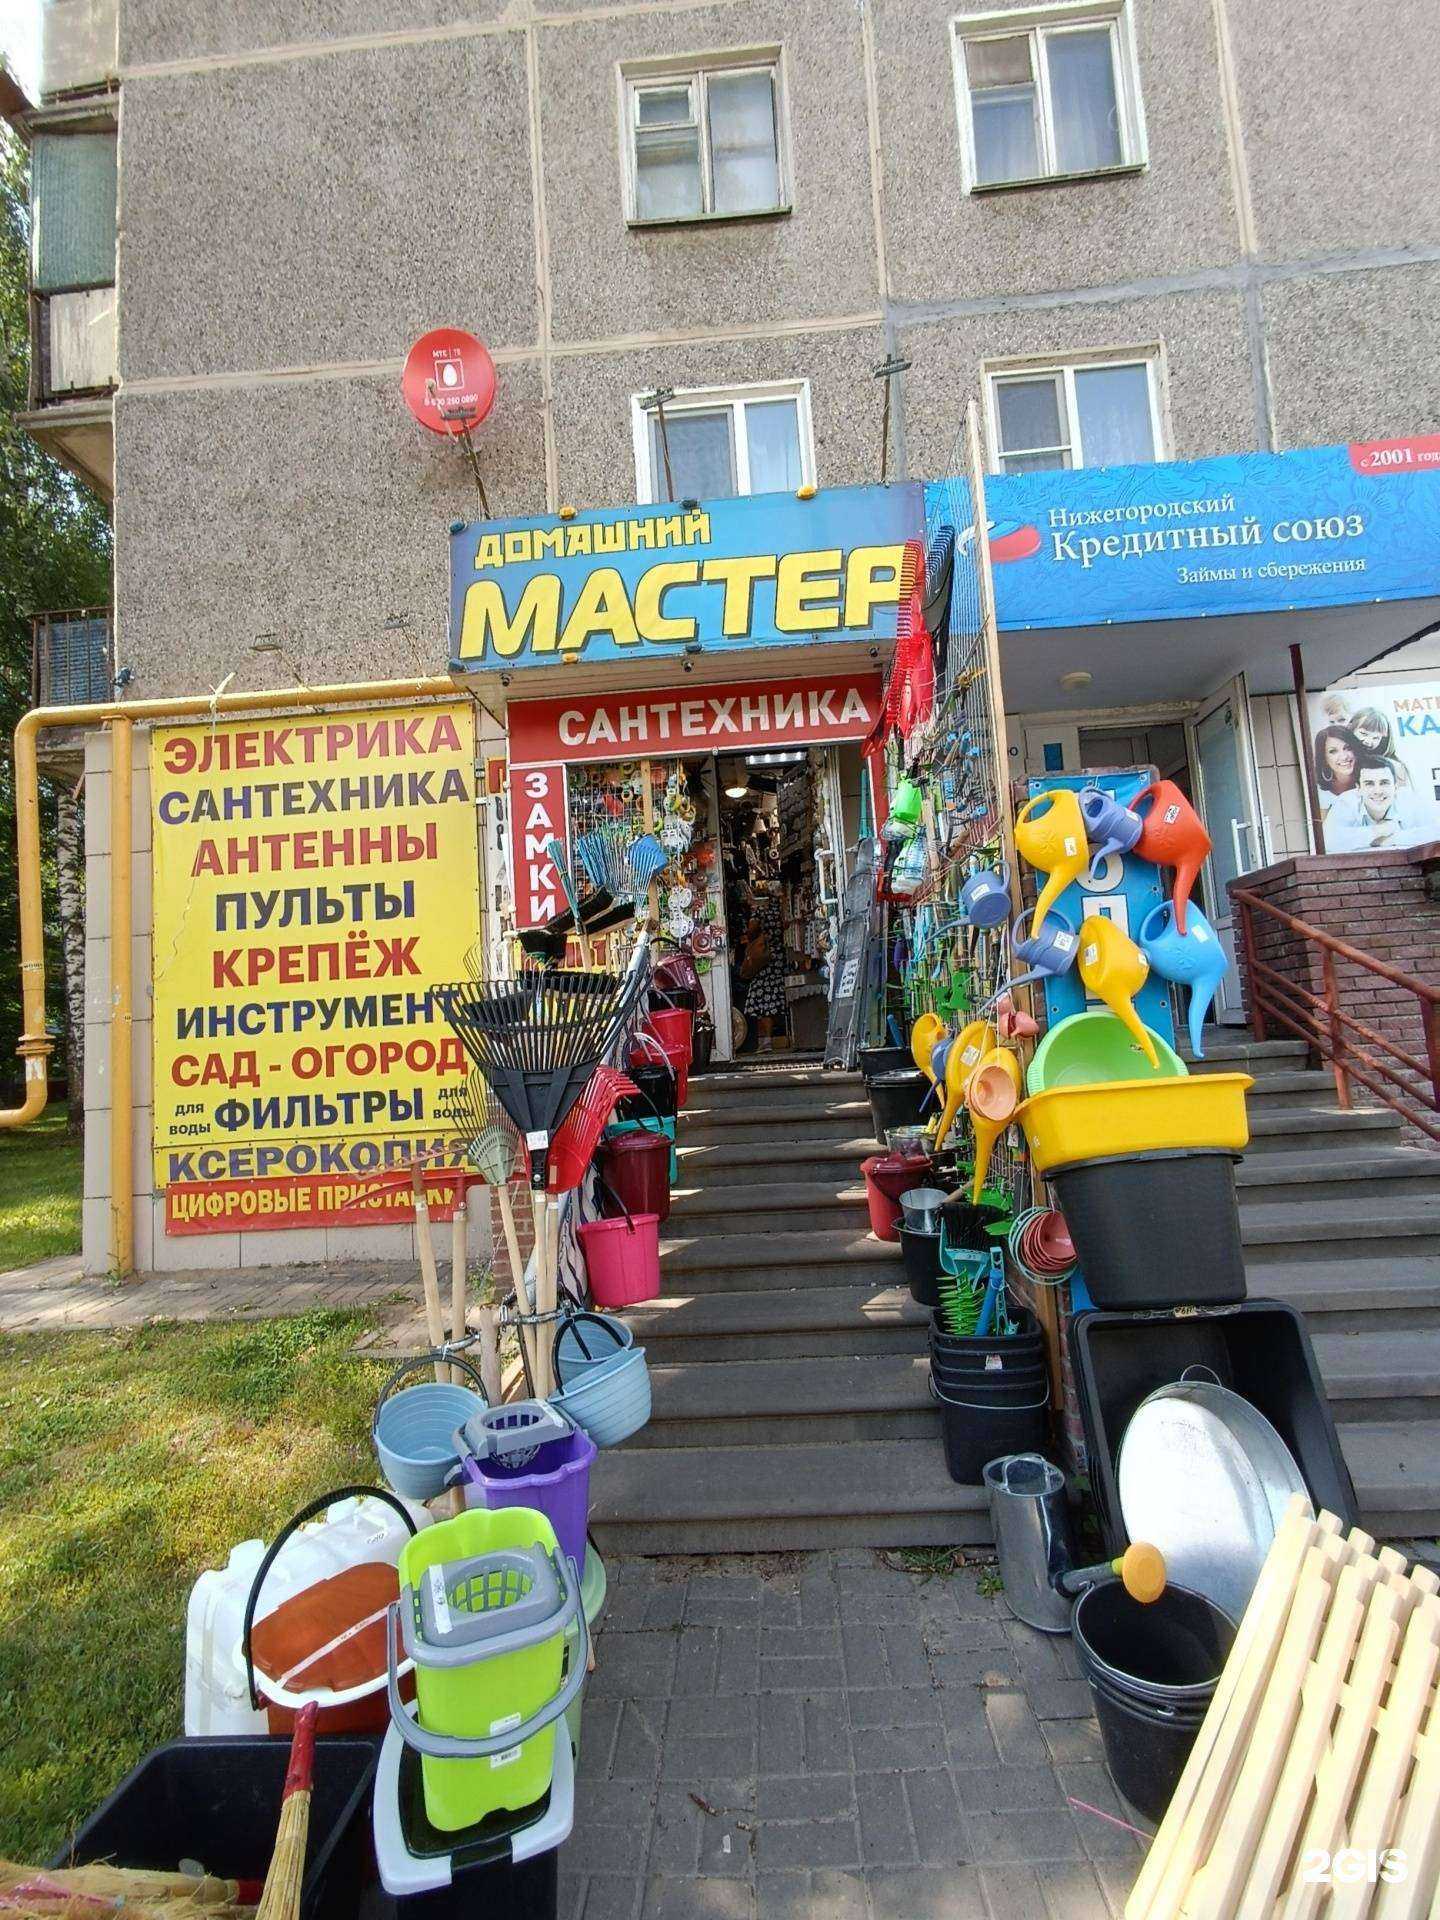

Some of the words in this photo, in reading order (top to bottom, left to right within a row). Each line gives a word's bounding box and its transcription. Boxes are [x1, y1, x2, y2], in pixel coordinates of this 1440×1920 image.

[1360, 458, 1369, 468] с
[1370, 447, 1413, 467] 2001
[1417, 451, 1440, 463] год
[1049, 493, 1236, 528] Нижегородский
[474, 508, 712, 570] ДОМАШНИЙ
[1053, 515, 1262, 568] Кредитный
[1272, 514, 1364, 545] союз
[1177, 564, 1236, 584] Займы
[1242, 566, 1253, 579] и
[1258, 558, 1367, 583] сбережения
[458, 545, 905, 661] МАСТЕР
[558, 688, 871, 746] САНТЕХНИКА
[163, 715, 462, 774] ЭЛЕКТРИКА
[158, 768, 470, 825] САНТЕХНИКА
[191, 822, 439, 877] АНТЕННЫ
[524, 772, 557, 923] ЗАМКИ
[215, 880, 416, 932] ПУЛЬТЫ
[213, 930, 422, 988] КРЕПЁЖ
[176, 990, 460, 1040] ИНСТРУМЕНТ
[171, 1050, 260, 1089] САД
[291, 1038, 468, 1080] ОГОРОД
[175, 1103, 204, 1117] для
[214, 1087, 424, 1132] ФИЛЬТРЫ
[438, 1087, 468, 1100] для
[169, 1123, 211, 1136] воды
[168, 1138, 475, 1182] КСЕРОКОПИЯ
[171, 1187, 312, 1221] ЦИФРОВЫЕ
